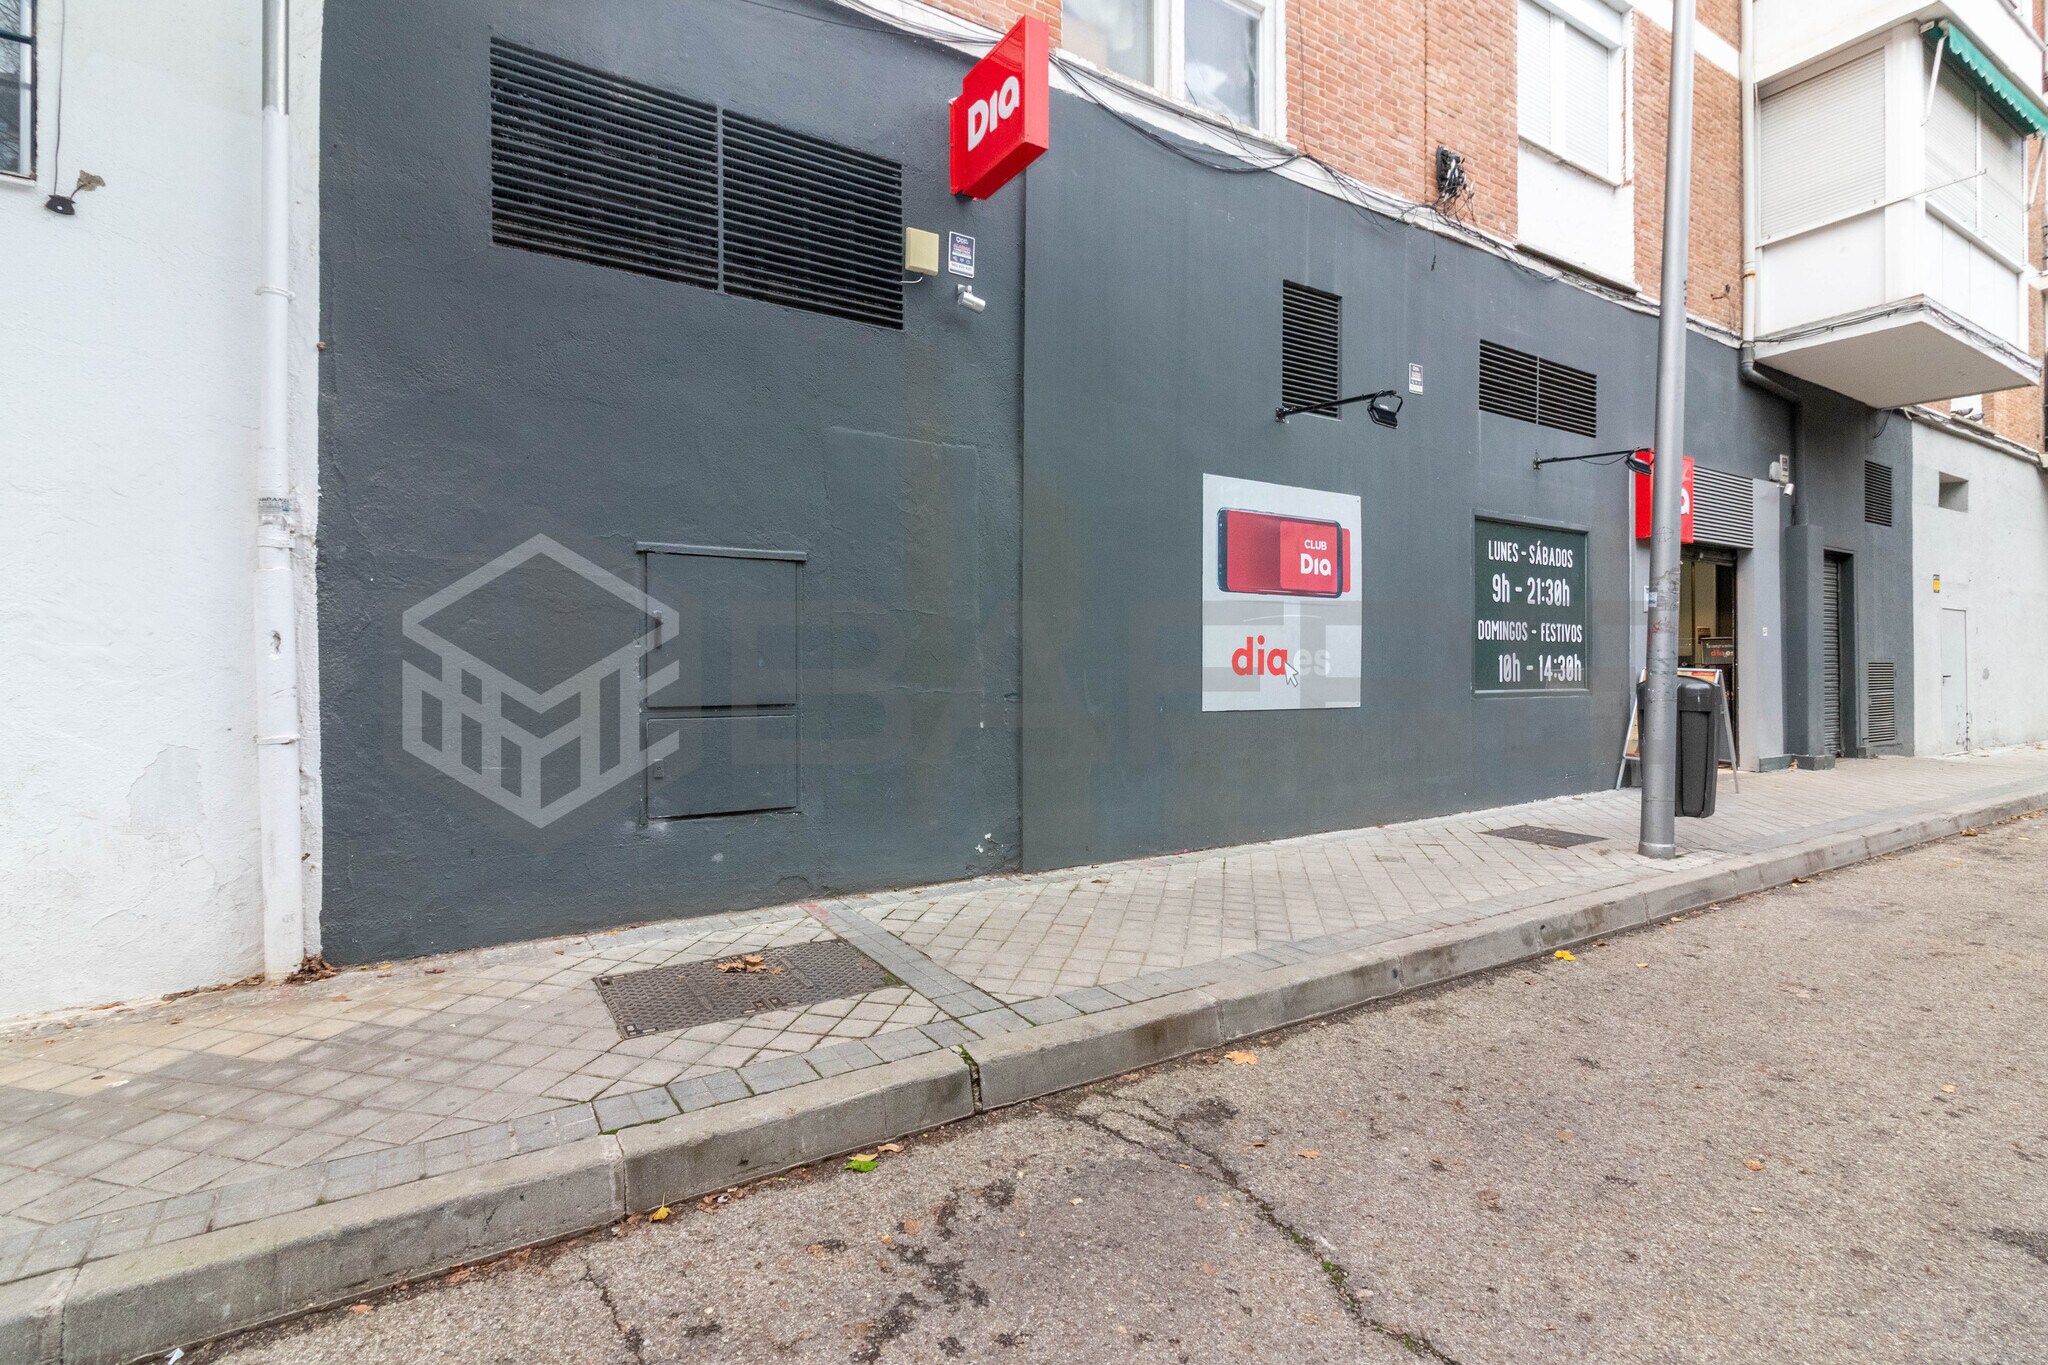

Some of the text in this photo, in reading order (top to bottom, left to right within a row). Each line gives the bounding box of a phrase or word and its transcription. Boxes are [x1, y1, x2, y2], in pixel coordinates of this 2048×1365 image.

[1304, 539, 1327, 551] CLUB
[1488, 540, 1519, 563] LUNES
[1529, 540, 1573, 568] SÁBADOS
[1492, 573, 1511, 603] 9h
[1526, 577, 1570, 607] 21:30h
[1477, 619, 1528, 642] DOMINGOS
[1540, 622, 1583, 643] FESTIVOS
[1498, 652, 1521, 683] 10h
[1538, 653, 1582, 683] 14:30h
